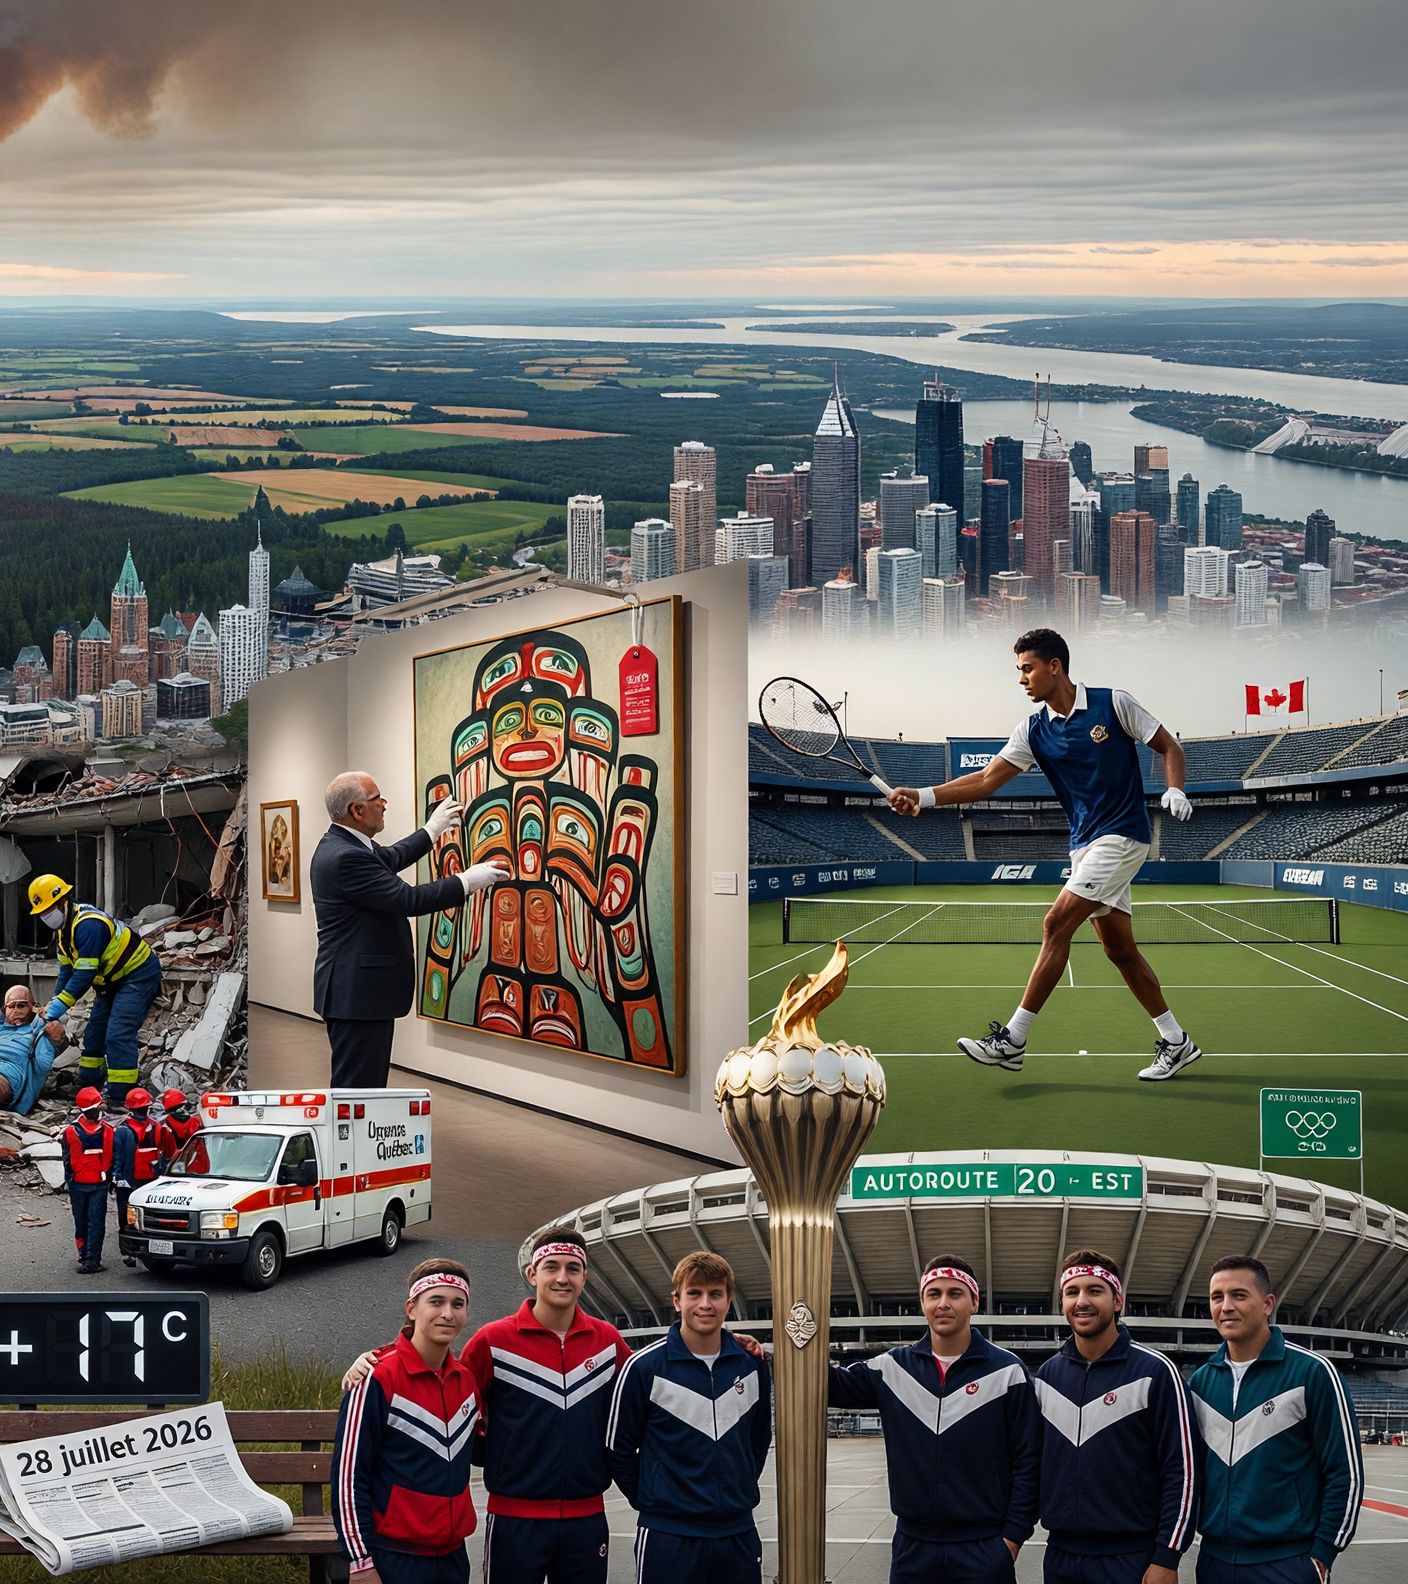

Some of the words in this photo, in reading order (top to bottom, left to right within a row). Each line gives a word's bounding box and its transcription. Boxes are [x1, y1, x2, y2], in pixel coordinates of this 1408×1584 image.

[991, 864, 1037, 880] IGA
[863, 1171, 999, 1192] AUTOROUTE
[1017, 1168, 1056, 1194] 20
[1092, 1172, 1132, 1191] EST
[16, 1449, 53, 1477] 28
[59, 1434, 138, 1477] juillet
[142, 1415, 213, 1453] 2026
